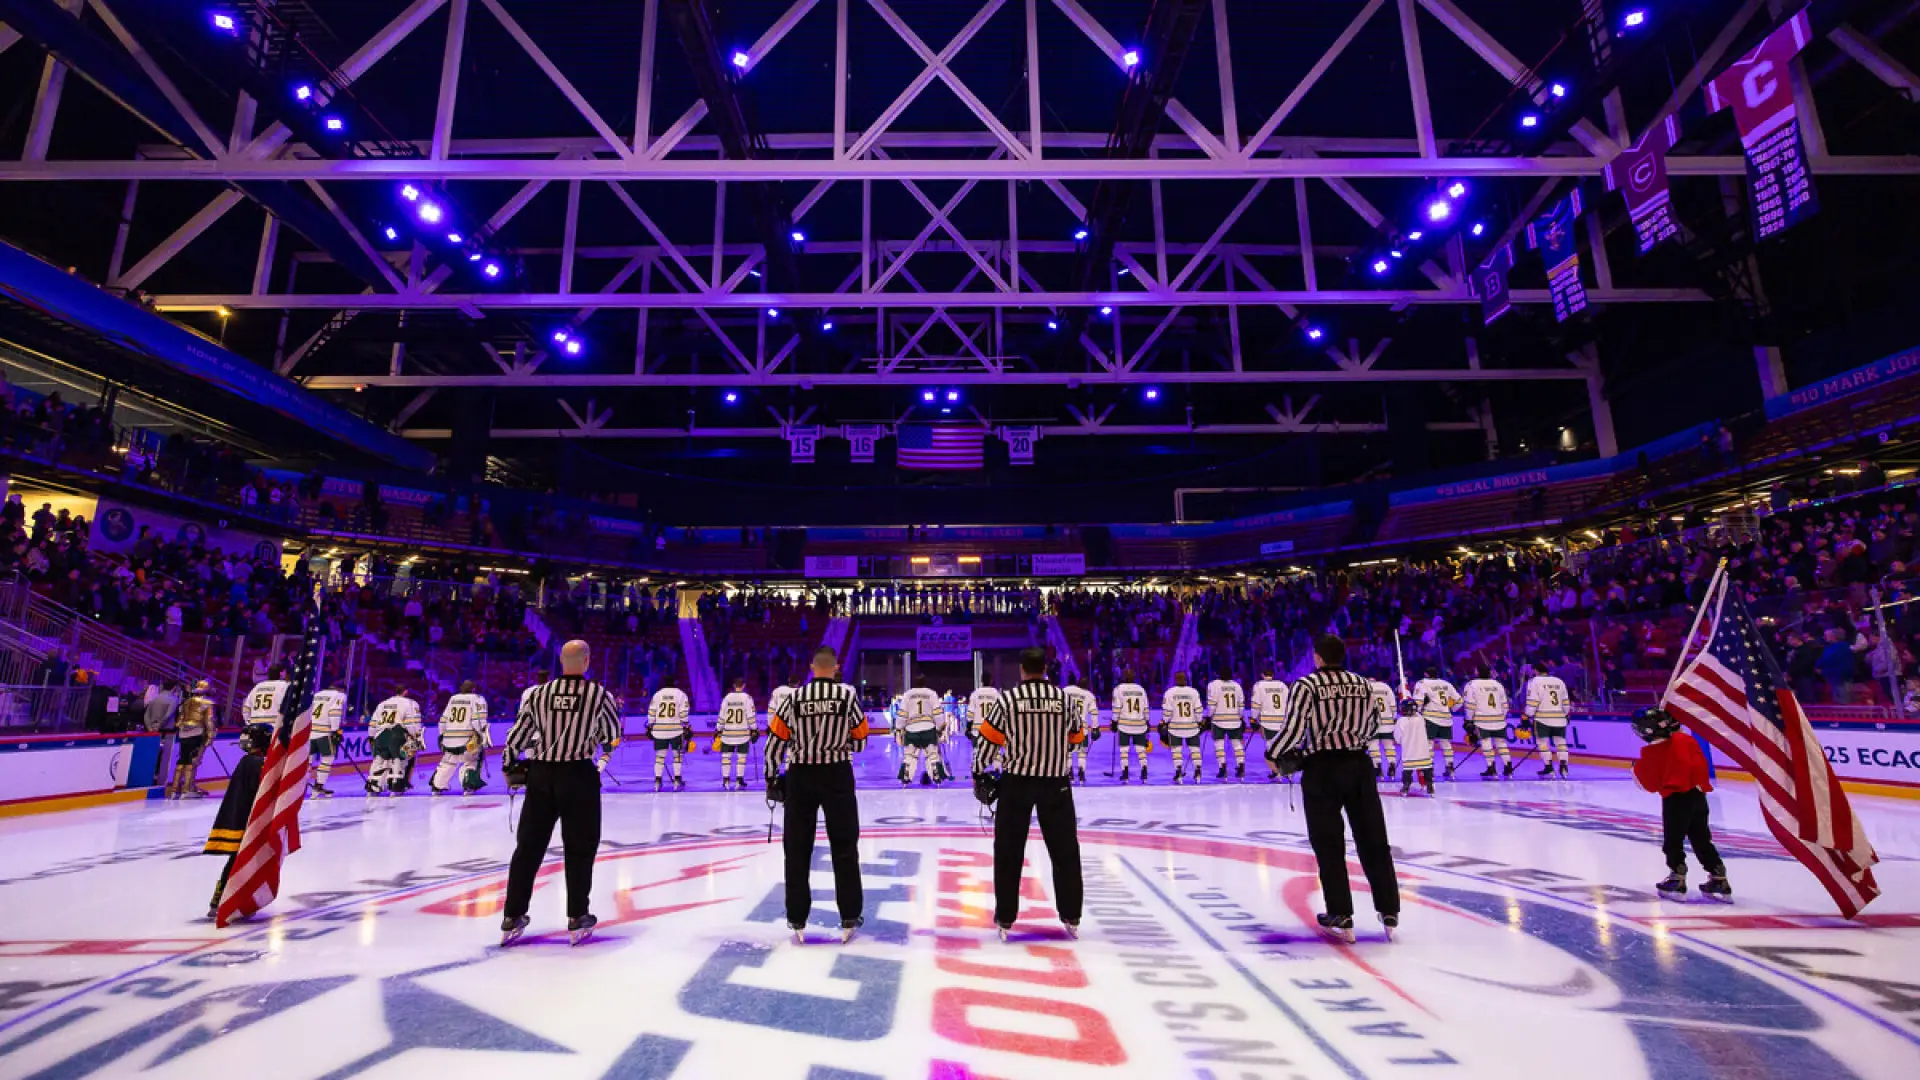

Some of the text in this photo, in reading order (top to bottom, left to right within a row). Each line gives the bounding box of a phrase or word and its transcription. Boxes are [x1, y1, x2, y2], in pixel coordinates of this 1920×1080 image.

[1742, 60, 1778, 108] C
[1823, 366, 1880, 396] MARK
[794, 437, 812, 453] 15
[855, 437, 871, 453] 16
[1012, 437, 1030, 453] 20
[1493, 470, 1547, 488] BROTEN
[1317, 684, 1367, 699] DAPUZZO
[1437, 691, 1448, 707] 5
[1548, 690, 1559, 706] 3
[254, 694, 273, 710] 55
[553, 695, 577, 710] REY
[799, 700, 842, 716] KENNEY
[916, 700, 923, 715] 1
[1016, 700, 1063, 713] WILLIAMS
[1126, 698, 1141, 714] 14
[1223, 693, 1237, 709] 11
[1271, 693, 1282, 710] 9
[1487, 693, 1497, 709] 4
[379, 711, 397, 725] 34
[449, 707, 467, 722] 30
[658, 702, 676, 718] 26
[726, 708, 744, 724] 20
[1176, 702, 1192, 718] 13
[925, 847, 1130, 1080] OCKEY
[1288, 977, 1460, 1065] LAKE
